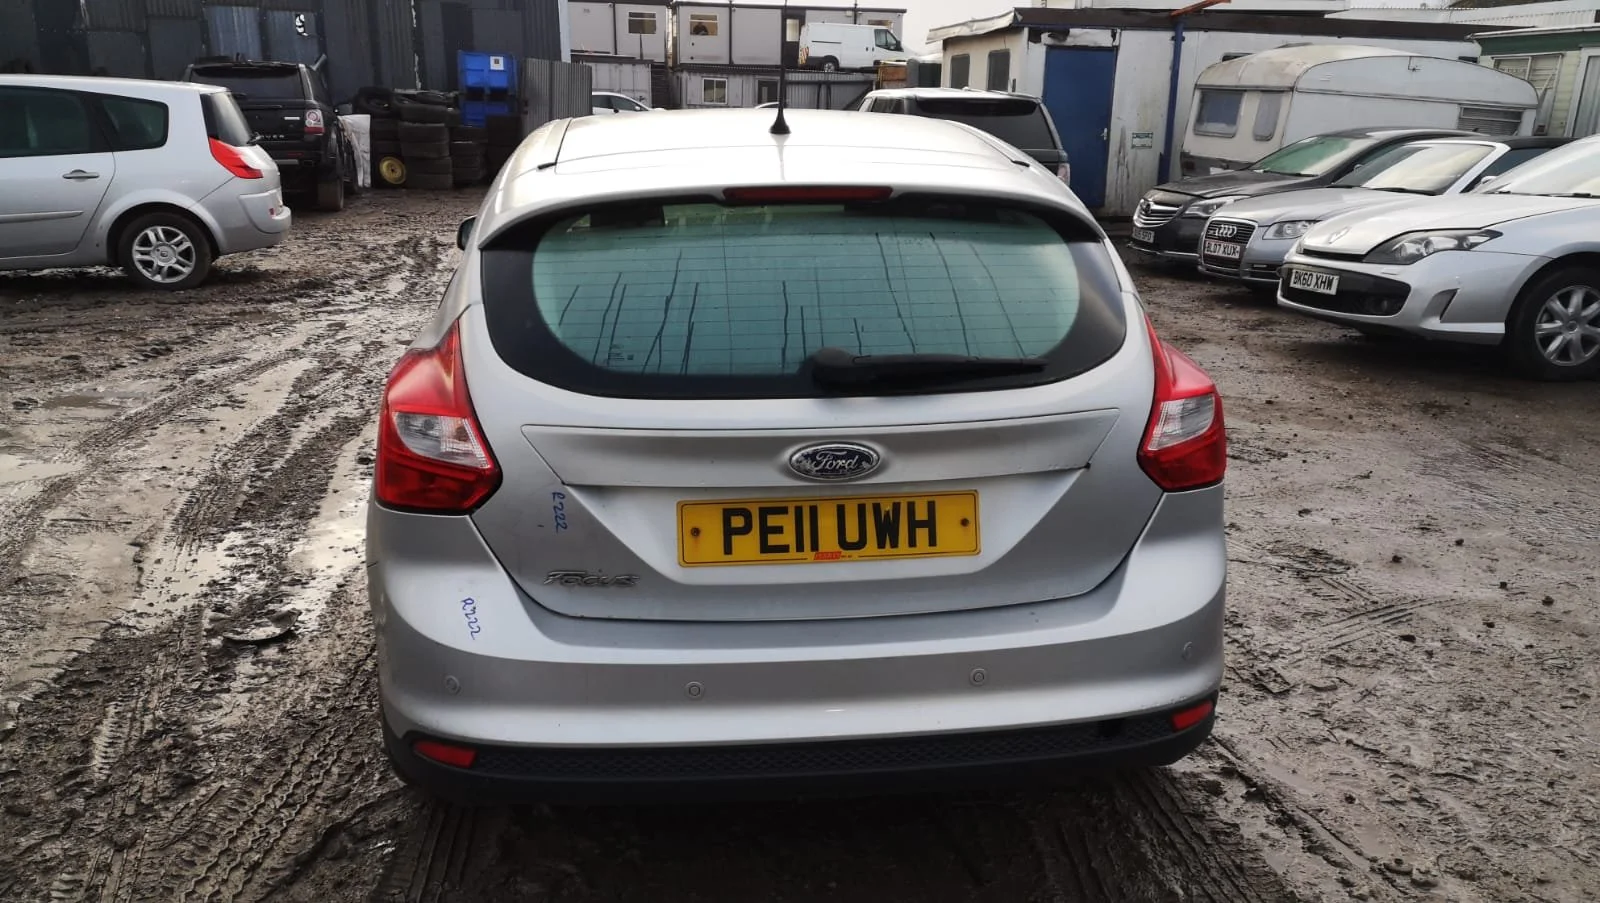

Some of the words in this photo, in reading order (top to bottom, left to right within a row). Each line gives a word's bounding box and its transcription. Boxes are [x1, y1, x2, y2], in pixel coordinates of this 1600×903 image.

[1222, 243, 1238, 257] XUX
[1293, 271, 1313, 287] BK60
[1313, 274, 1335, 291] XHW
[812, 450, 859, 472] Ford
[722, 504, 820, 555] PE11
[836, 500, 938, 551] UWH
